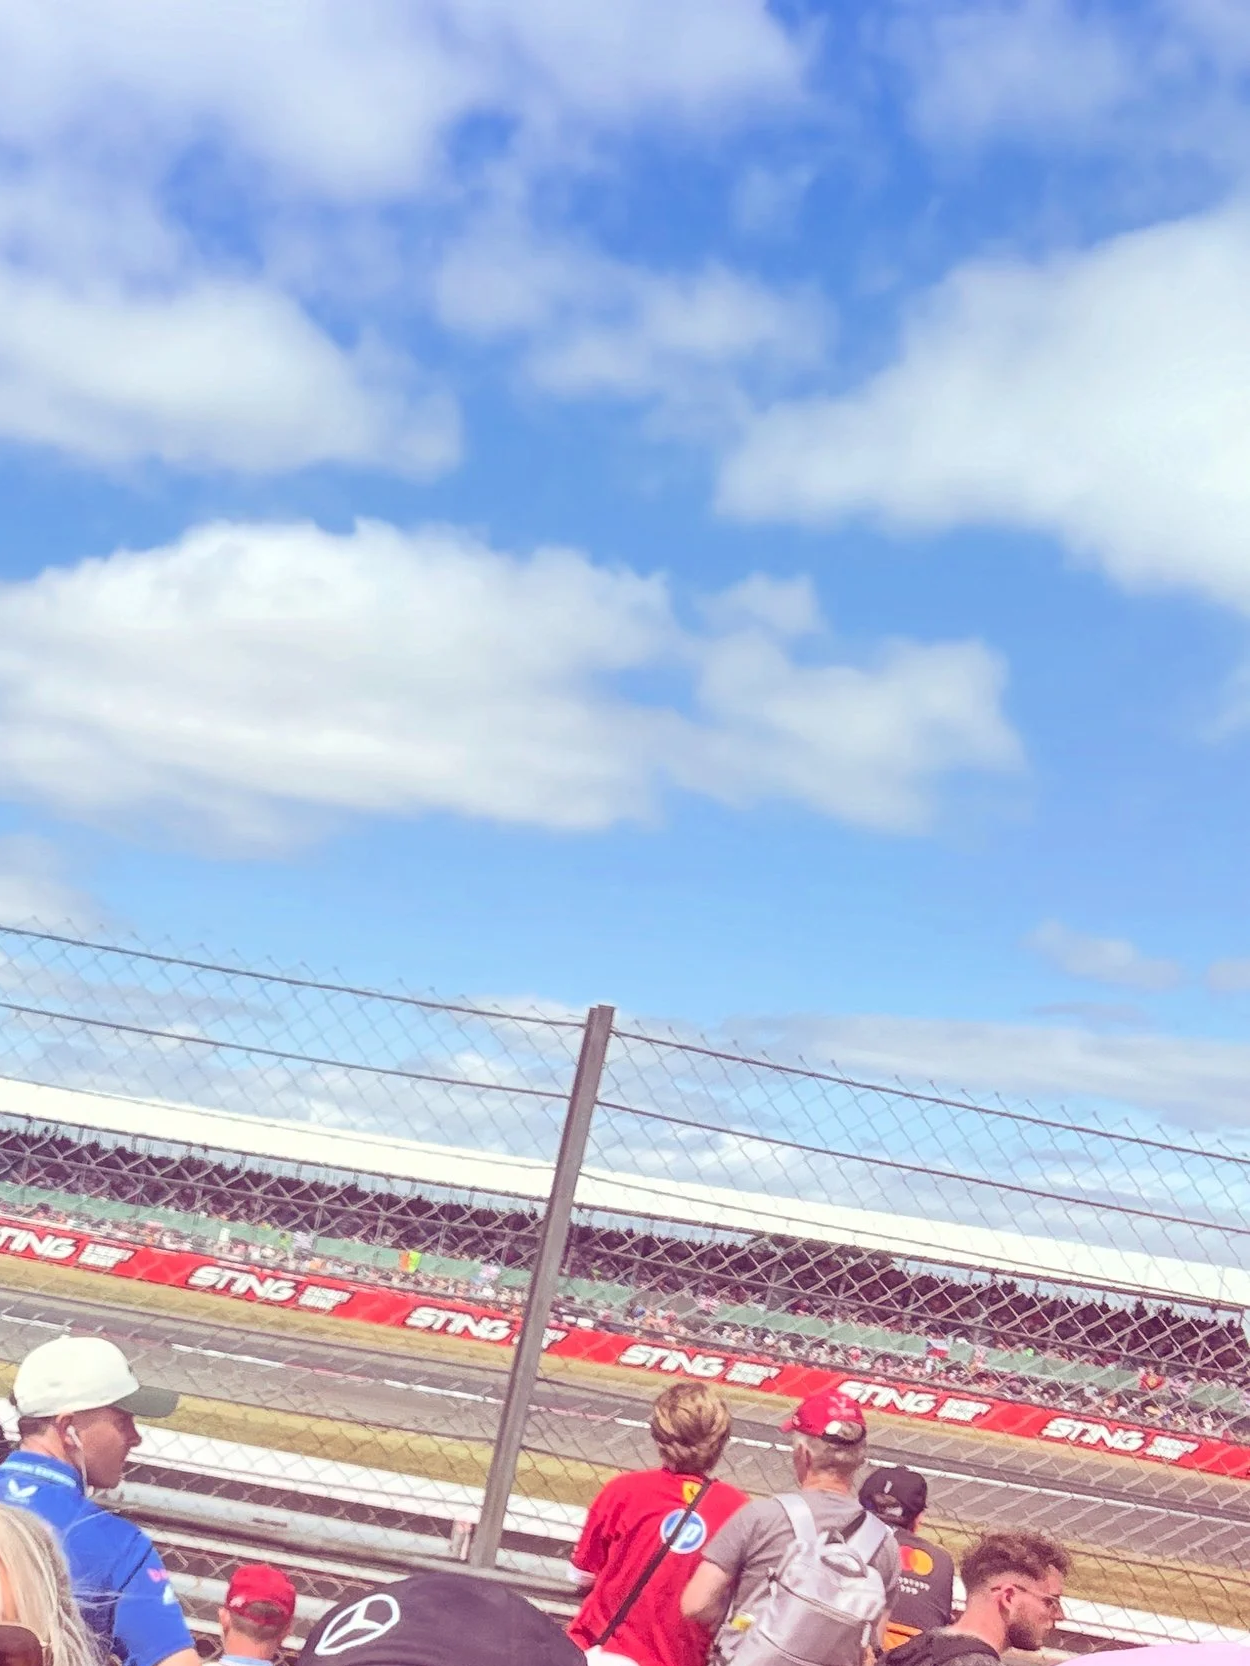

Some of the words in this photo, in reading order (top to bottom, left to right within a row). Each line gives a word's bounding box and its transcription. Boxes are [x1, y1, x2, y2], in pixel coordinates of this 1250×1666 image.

[188, 1265, 297, 1301] STING
[405, 1306, 512, 1341] STING
[619, 1344, 725, 1377] STING
[838, 1380, 937, 1414] STING
[1042, 1417, 1145, 1452] STING
